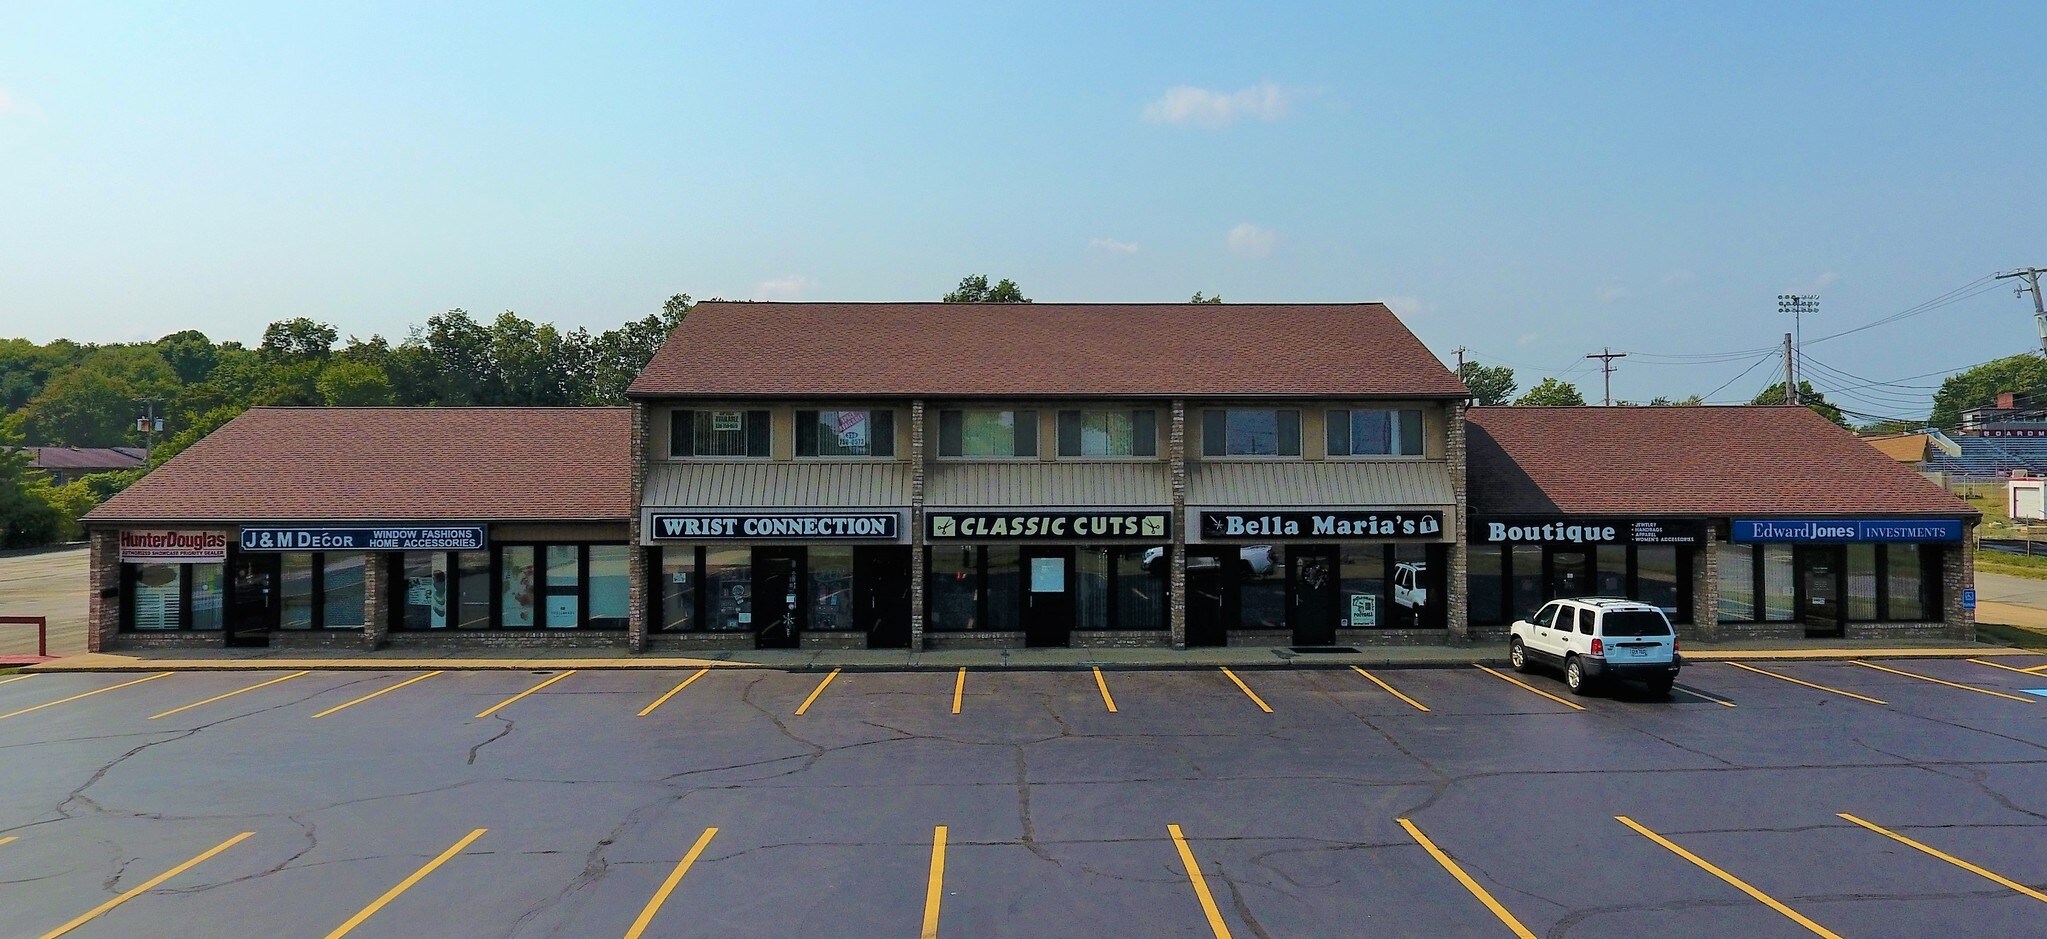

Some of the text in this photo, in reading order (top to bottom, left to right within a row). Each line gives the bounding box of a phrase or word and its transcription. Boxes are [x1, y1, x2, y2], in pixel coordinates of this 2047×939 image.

[373, 529, 473, 539] WINDOW FASHIONS
[662, 517, 887, 536] WRIST CONNECTION
[960, 516, 1138, 536] CLASSIC CUTS
[1225, 515, 1416, 535] Bella Maria's
[1487, 521, 1616, 543] Boutique
[1866, 527, 1946, 538] INVESTMENTS
[369, 538, 476, 548] HOME ACCESSORIES
